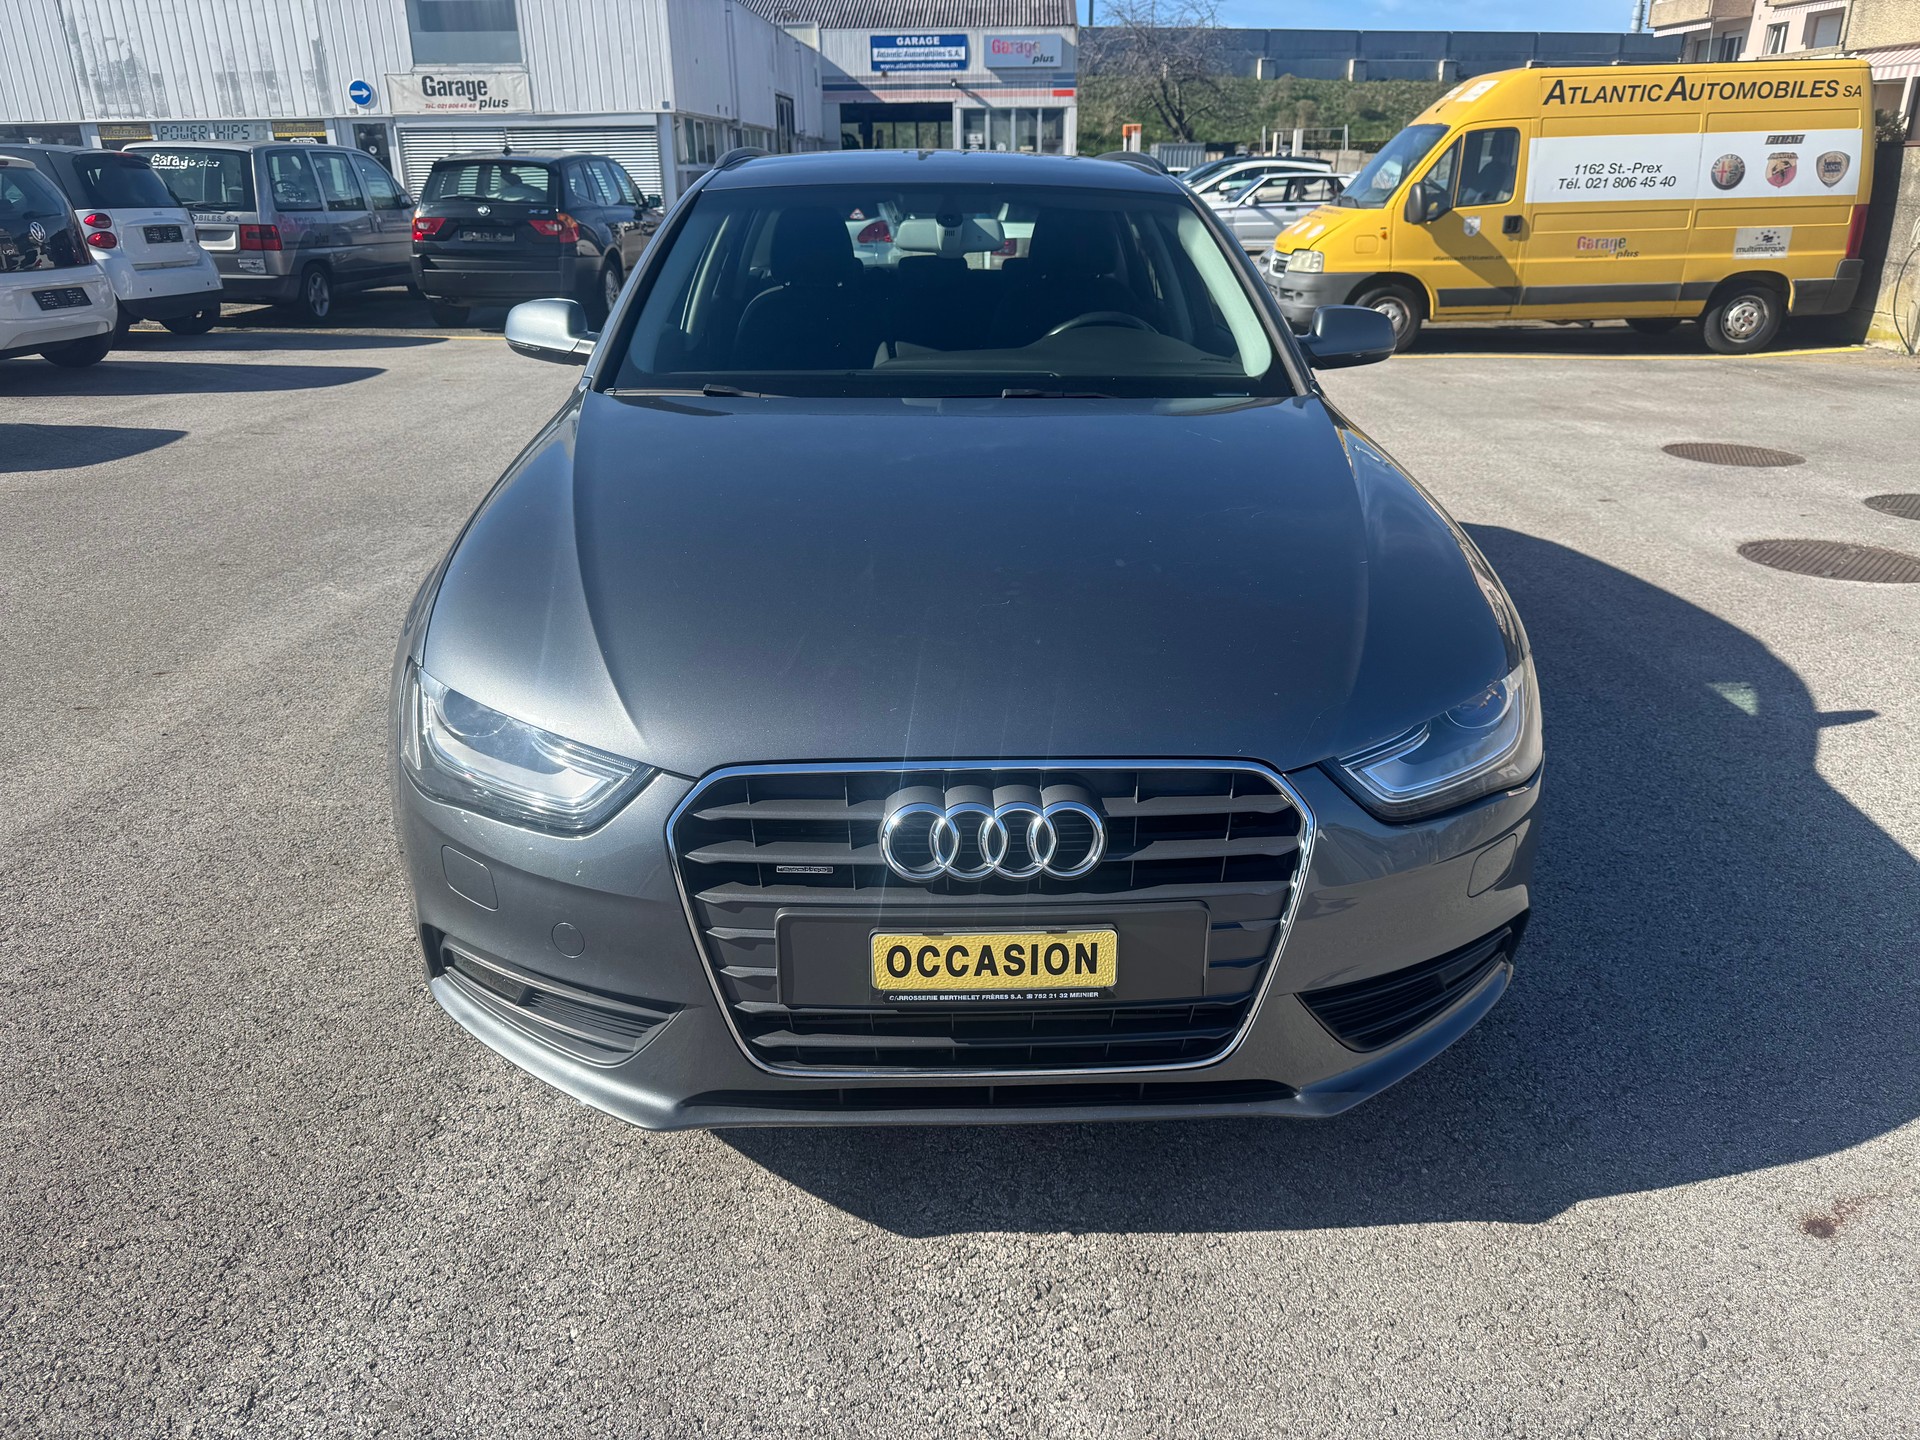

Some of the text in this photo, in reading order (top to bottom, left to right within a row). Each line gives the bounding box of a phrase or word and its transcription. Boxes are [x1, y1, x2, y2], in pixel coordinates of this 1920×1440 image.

[896, 36, 940, 45] GARAGE
[876, 50, 902, 58] Atlantic
[991, 38, 1041, 58] Garage
[1032, 54, 1054, 64] plus
[421, 75, 488, 101] Garage
[1842, 84, 1862, 98] SA
[479, 97, 509, 110] plus
[160, 124, 207, 140] POWER
[215, 124, 250, 140] HIPS
[1768, 136, 1803, 144] FIAT
[1574, 162, 1663, 175] 1162 St.-Prex
[1558, 175, 1677, 190] Tél. 021 806 45 40
[1577, 236, 1626, 254] Garage
[1616, 249, 1639, 259] plus
[886, 942, 1099, 978] OCCASION
